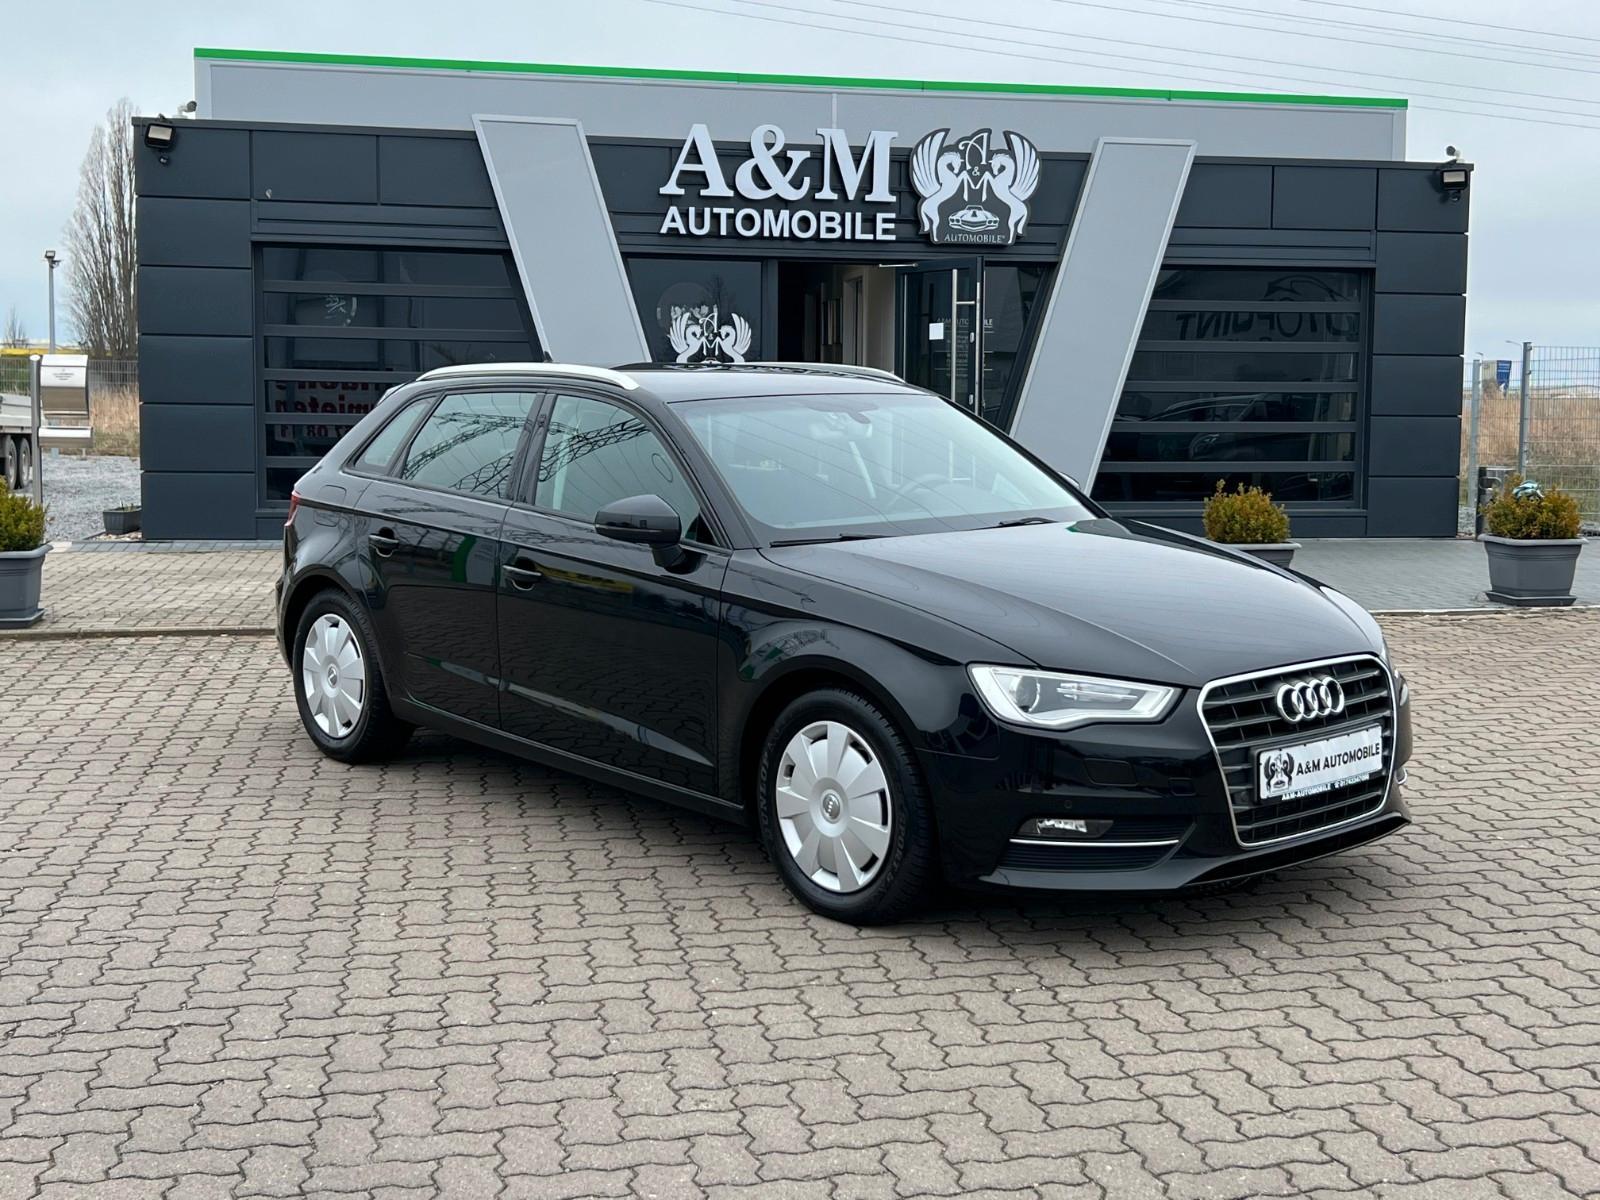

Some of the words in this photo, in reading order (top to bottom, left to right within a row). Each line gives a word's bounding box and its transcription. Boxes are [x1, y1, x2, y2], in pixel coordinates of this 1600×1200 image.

[659, 123, 899, 203] A&M
[659, 206, 897, 241] AUTOMOBILE
[1296, 758, 1321, 776] A&M
[1323, 743, 1380, 770] AUTOMOBILE
